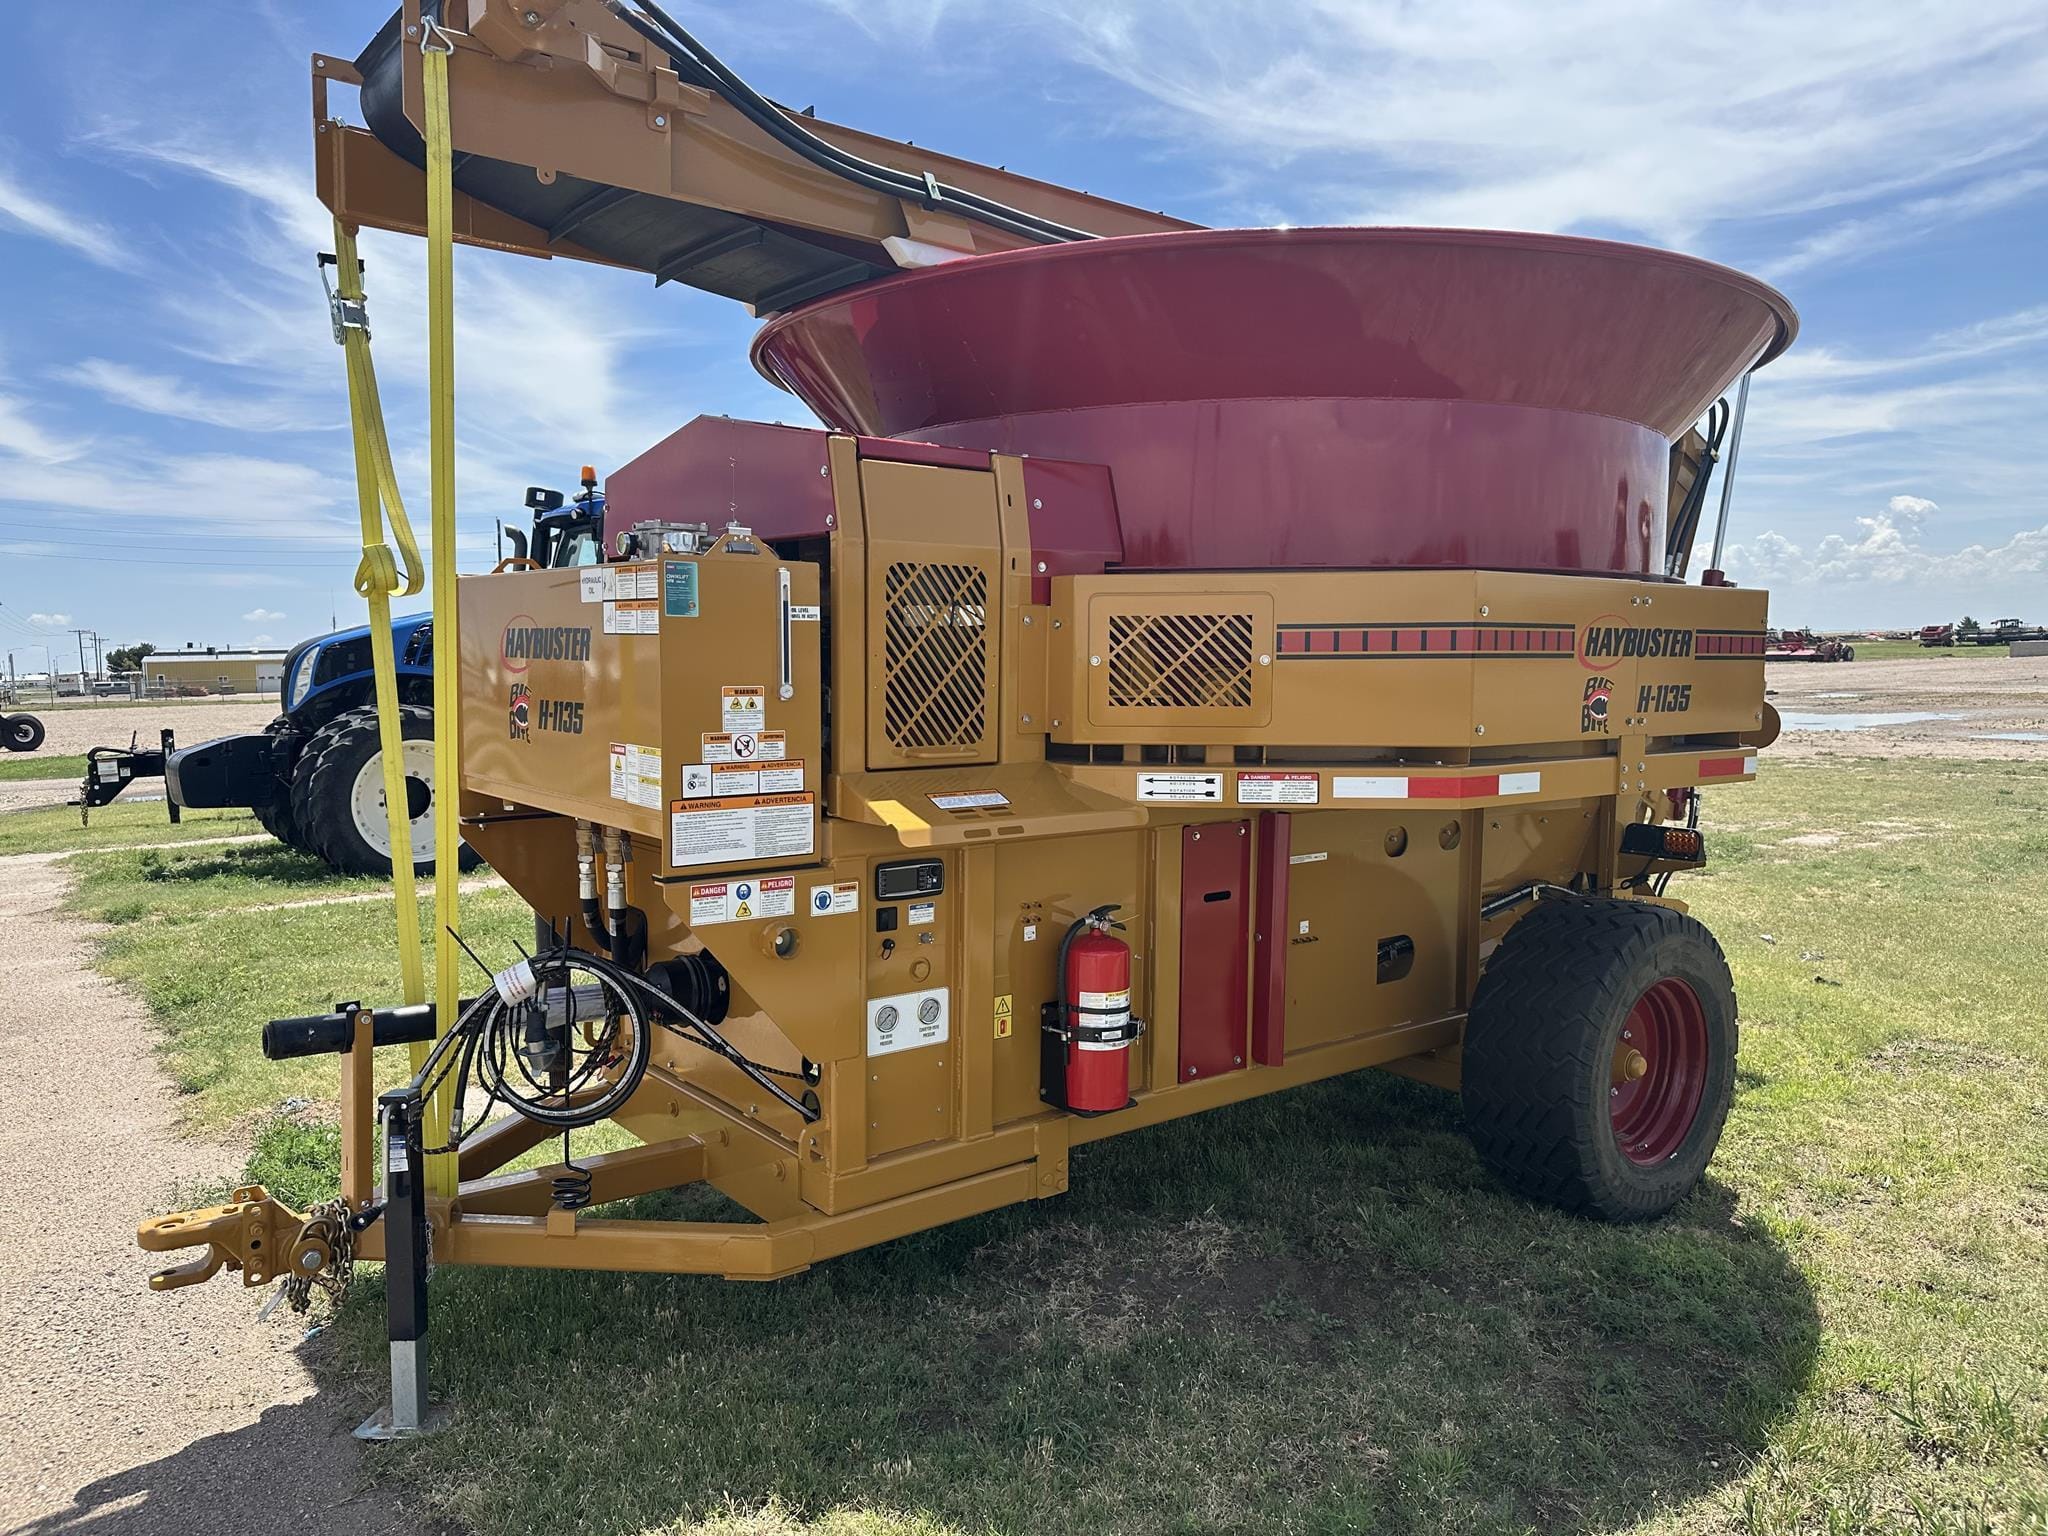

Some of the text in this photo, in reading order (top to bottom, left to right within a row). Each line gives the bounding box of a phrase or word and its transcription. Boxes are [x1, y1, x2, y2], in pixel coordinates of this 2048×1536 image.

[505, 627, 591, 661] HAYBUSTER
[1584, 627, 1693, 657] HAYBUSTER
[1583, 676, 1614, 701] BIG
[1636, 684, 1692, 713] H-1135
[538, 700, 584, 734] H-1135
[1581, 704, 1609, 734] BITE
[761, 795, 807, 804] ADVERTENCIA
[700, 886, 726, 895] DANGER
[767, 879, 793, 888] PELIGRO
